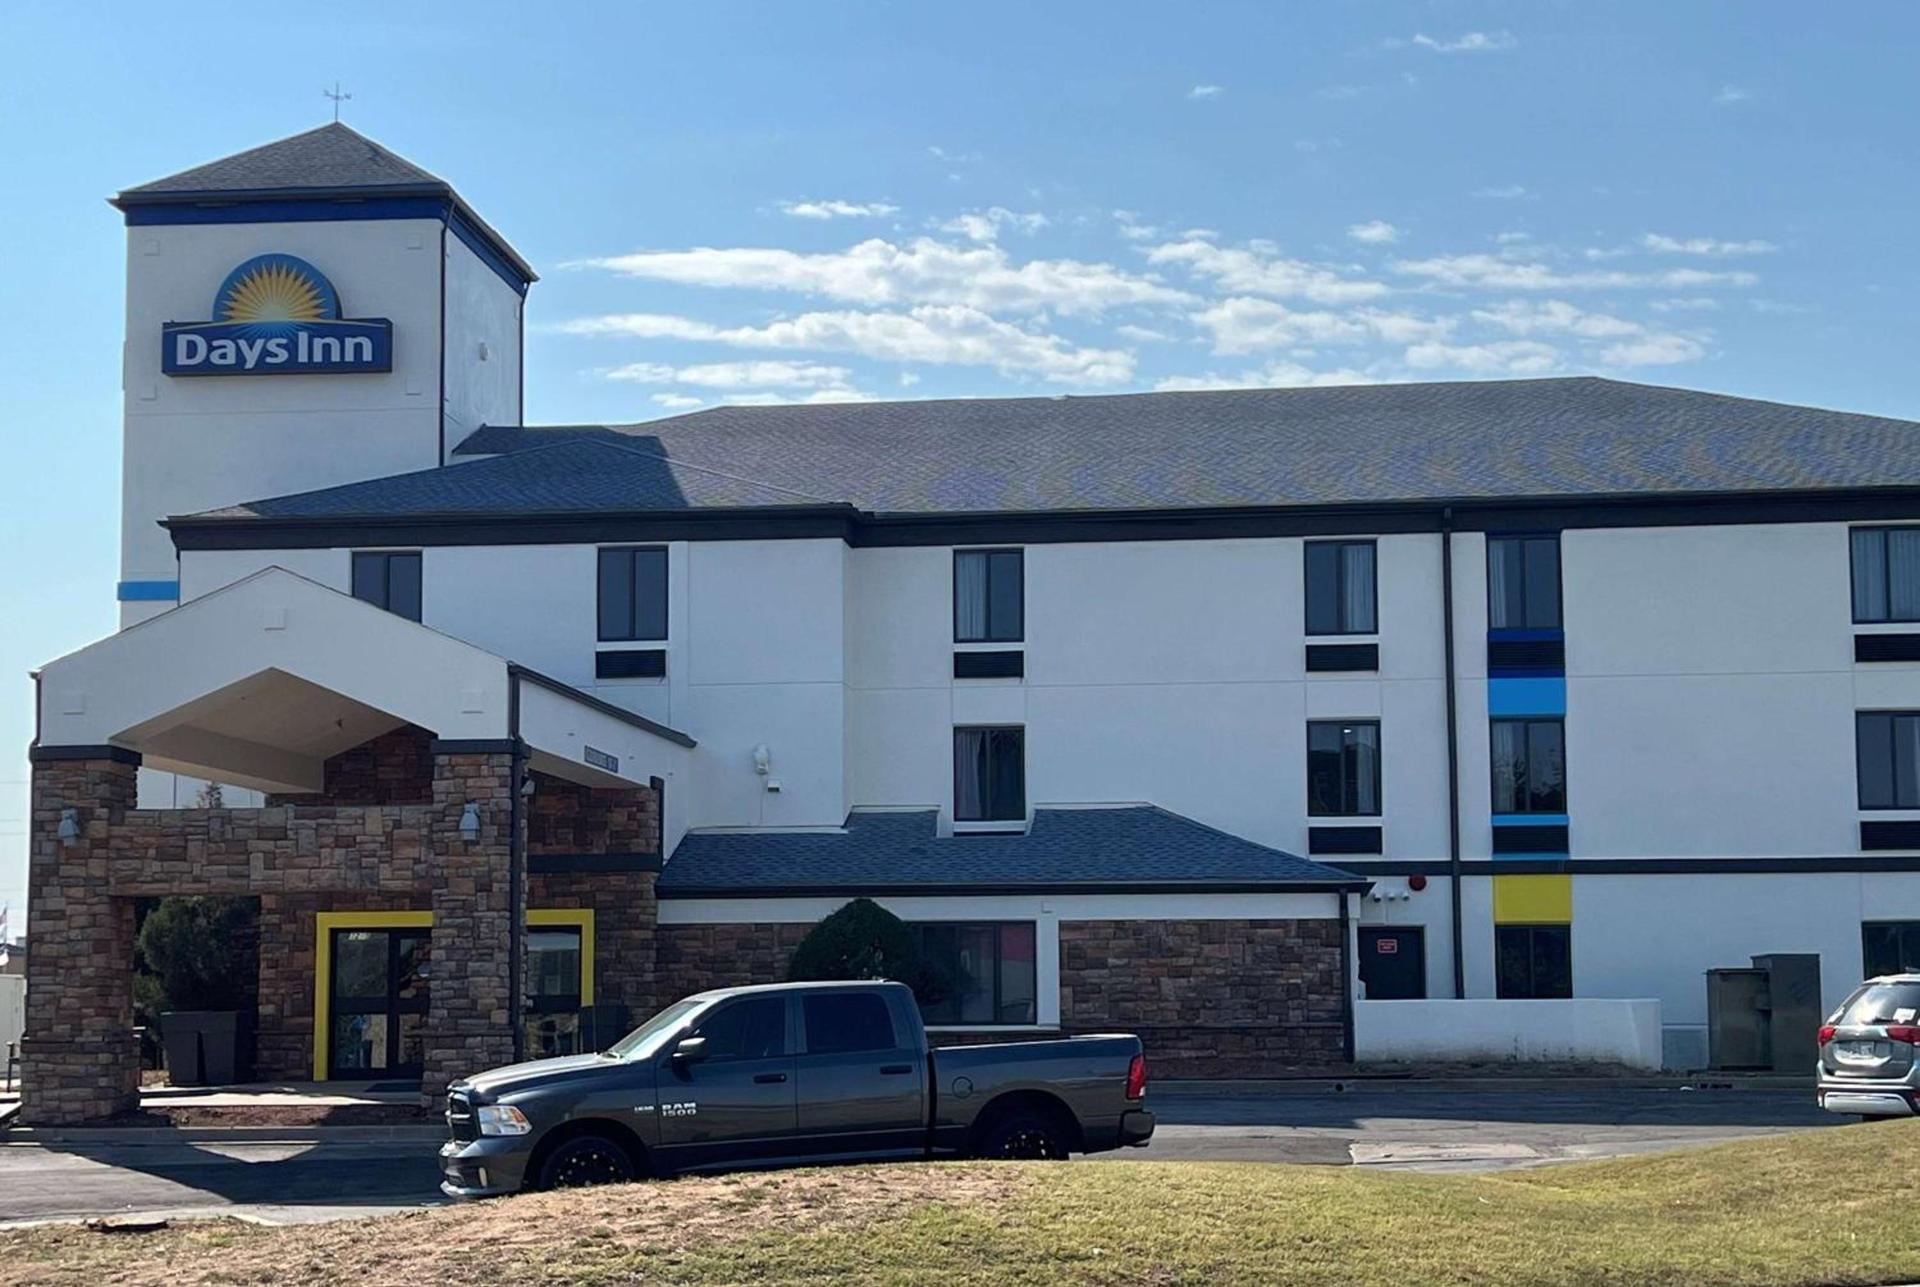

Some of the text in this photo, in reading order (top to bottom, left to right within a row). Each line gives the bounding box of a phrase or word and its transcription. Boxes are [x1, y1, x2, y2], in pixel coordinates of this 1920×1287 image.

[176, 332, 373, 369] Days Inn
[662, 1102, 696, 1110] RAM
[662, 1109, 697, 1117] 1500
